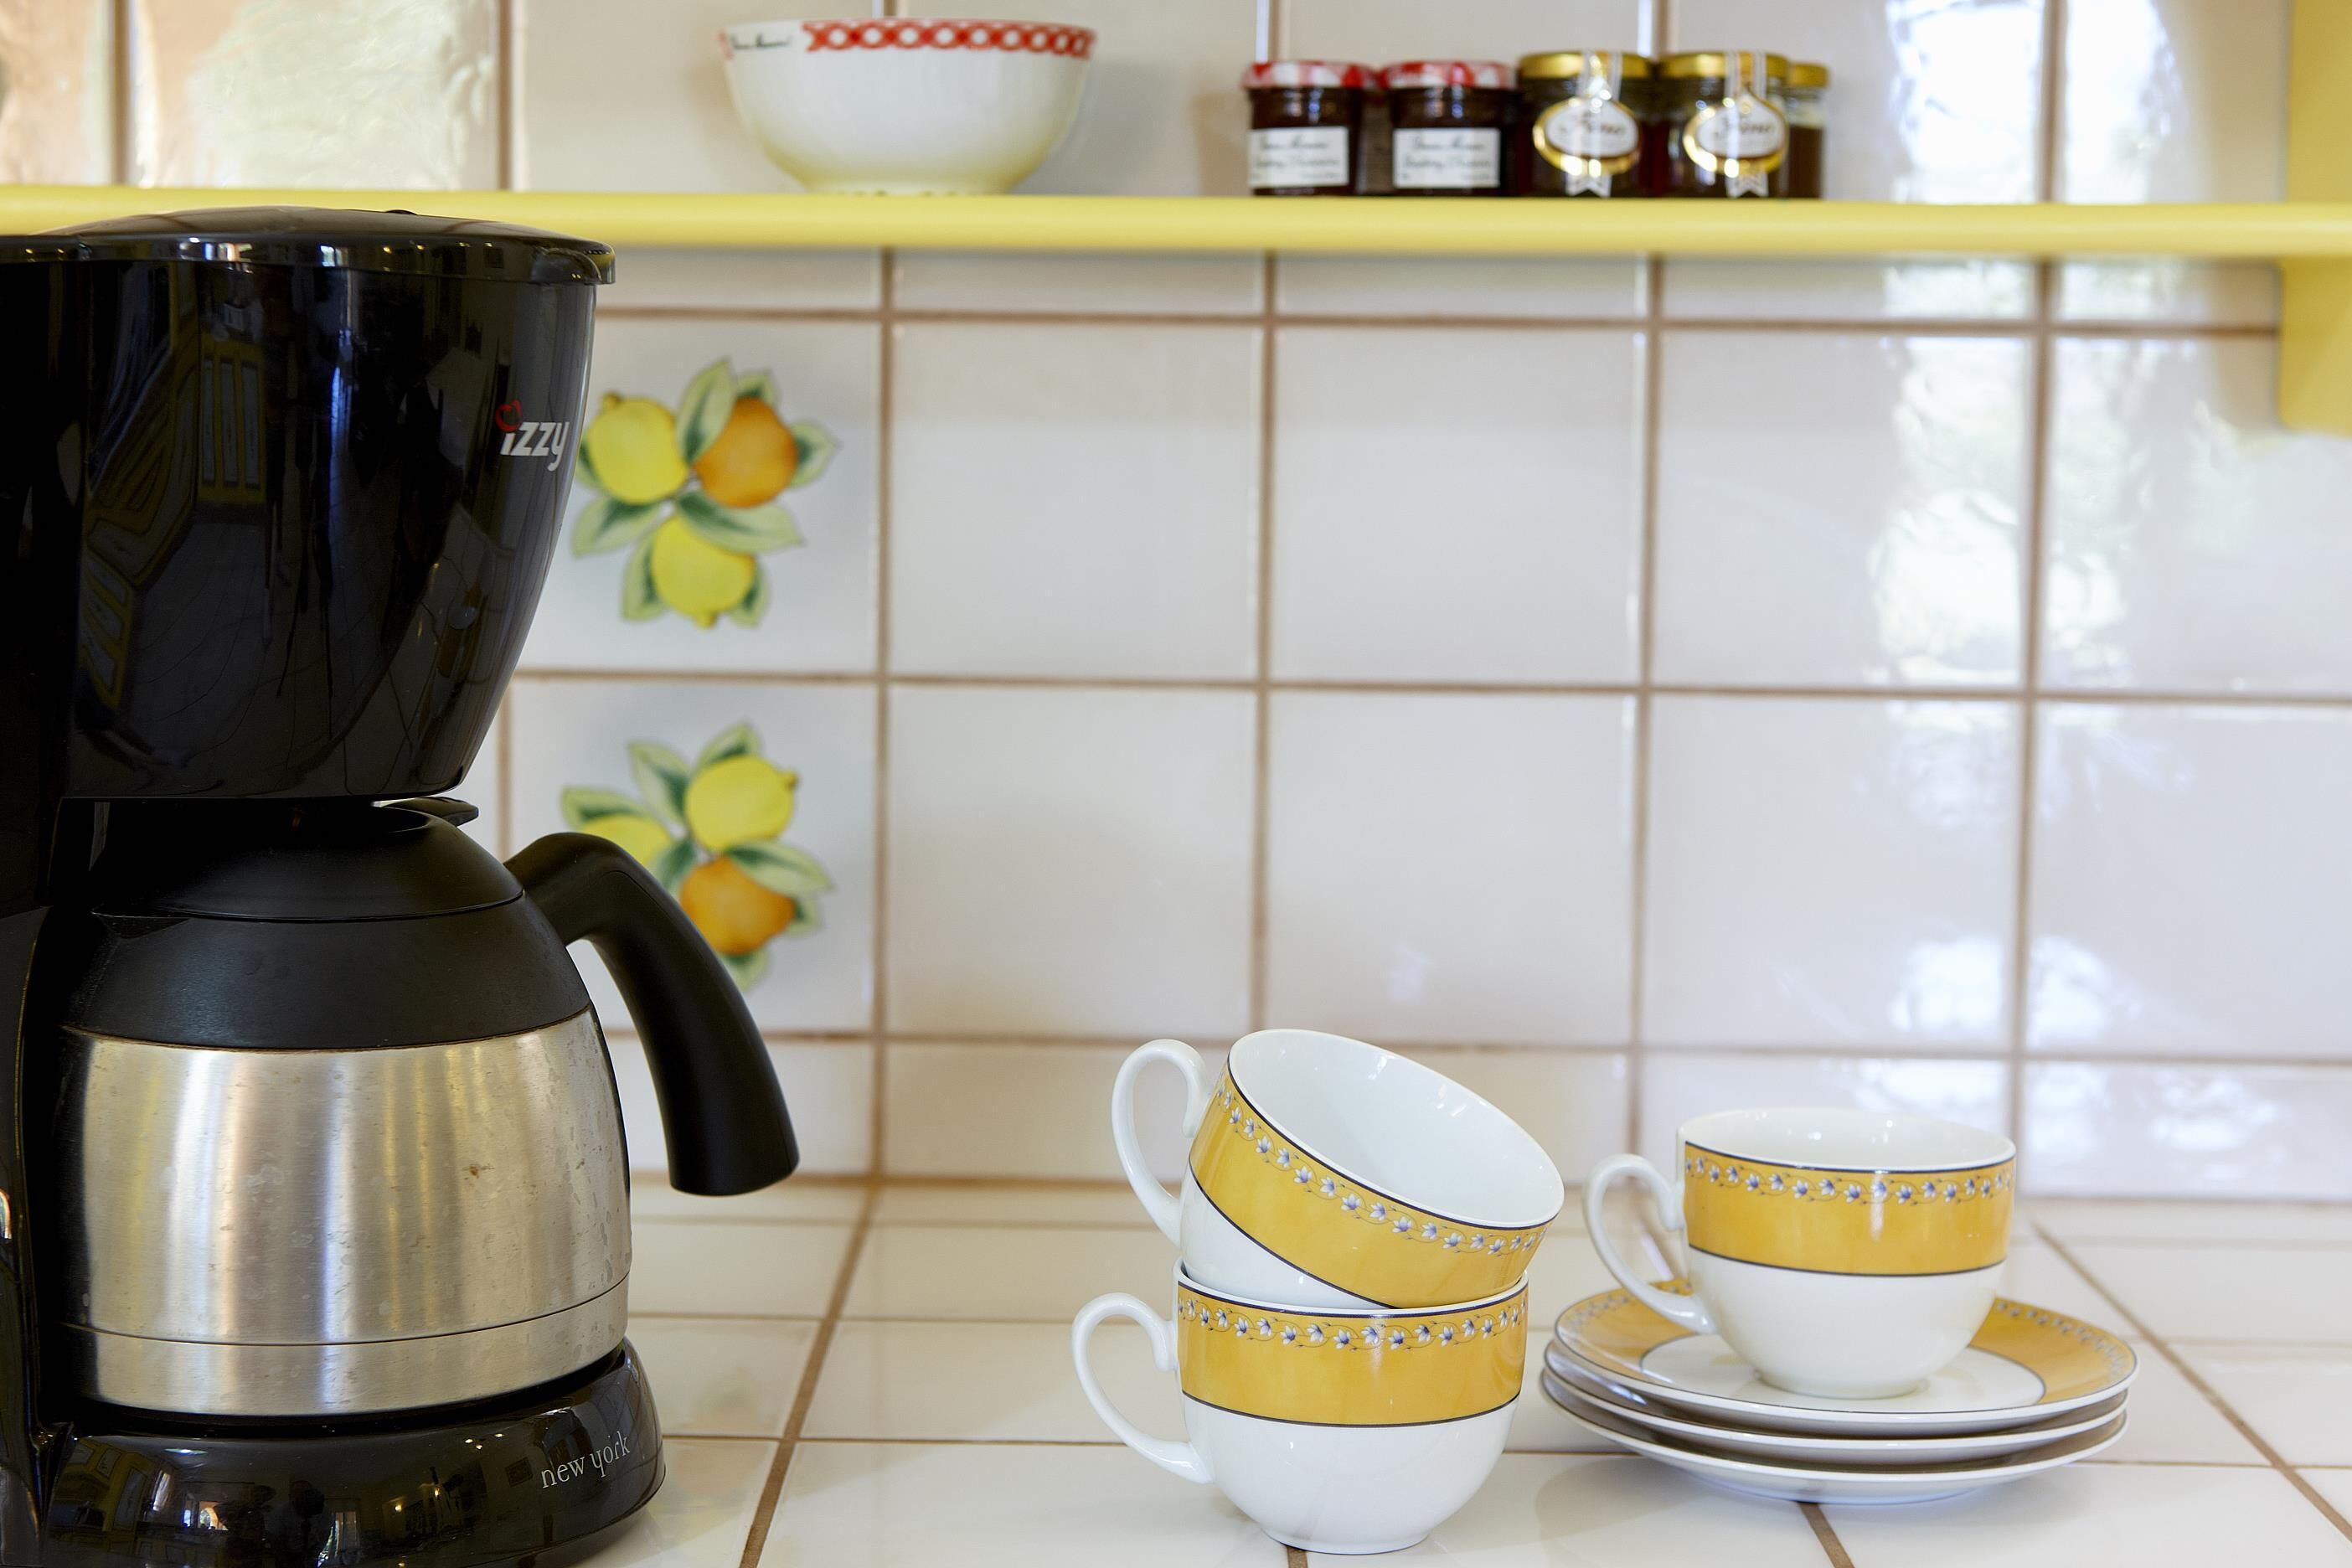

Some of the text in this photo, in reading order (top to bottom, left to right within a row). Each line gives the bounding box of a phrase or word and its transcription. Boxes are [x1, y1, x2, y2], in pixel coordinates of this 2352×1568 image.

[500, 421, 570, 472] izzy
[541, 1430, 630, 1488] new york
